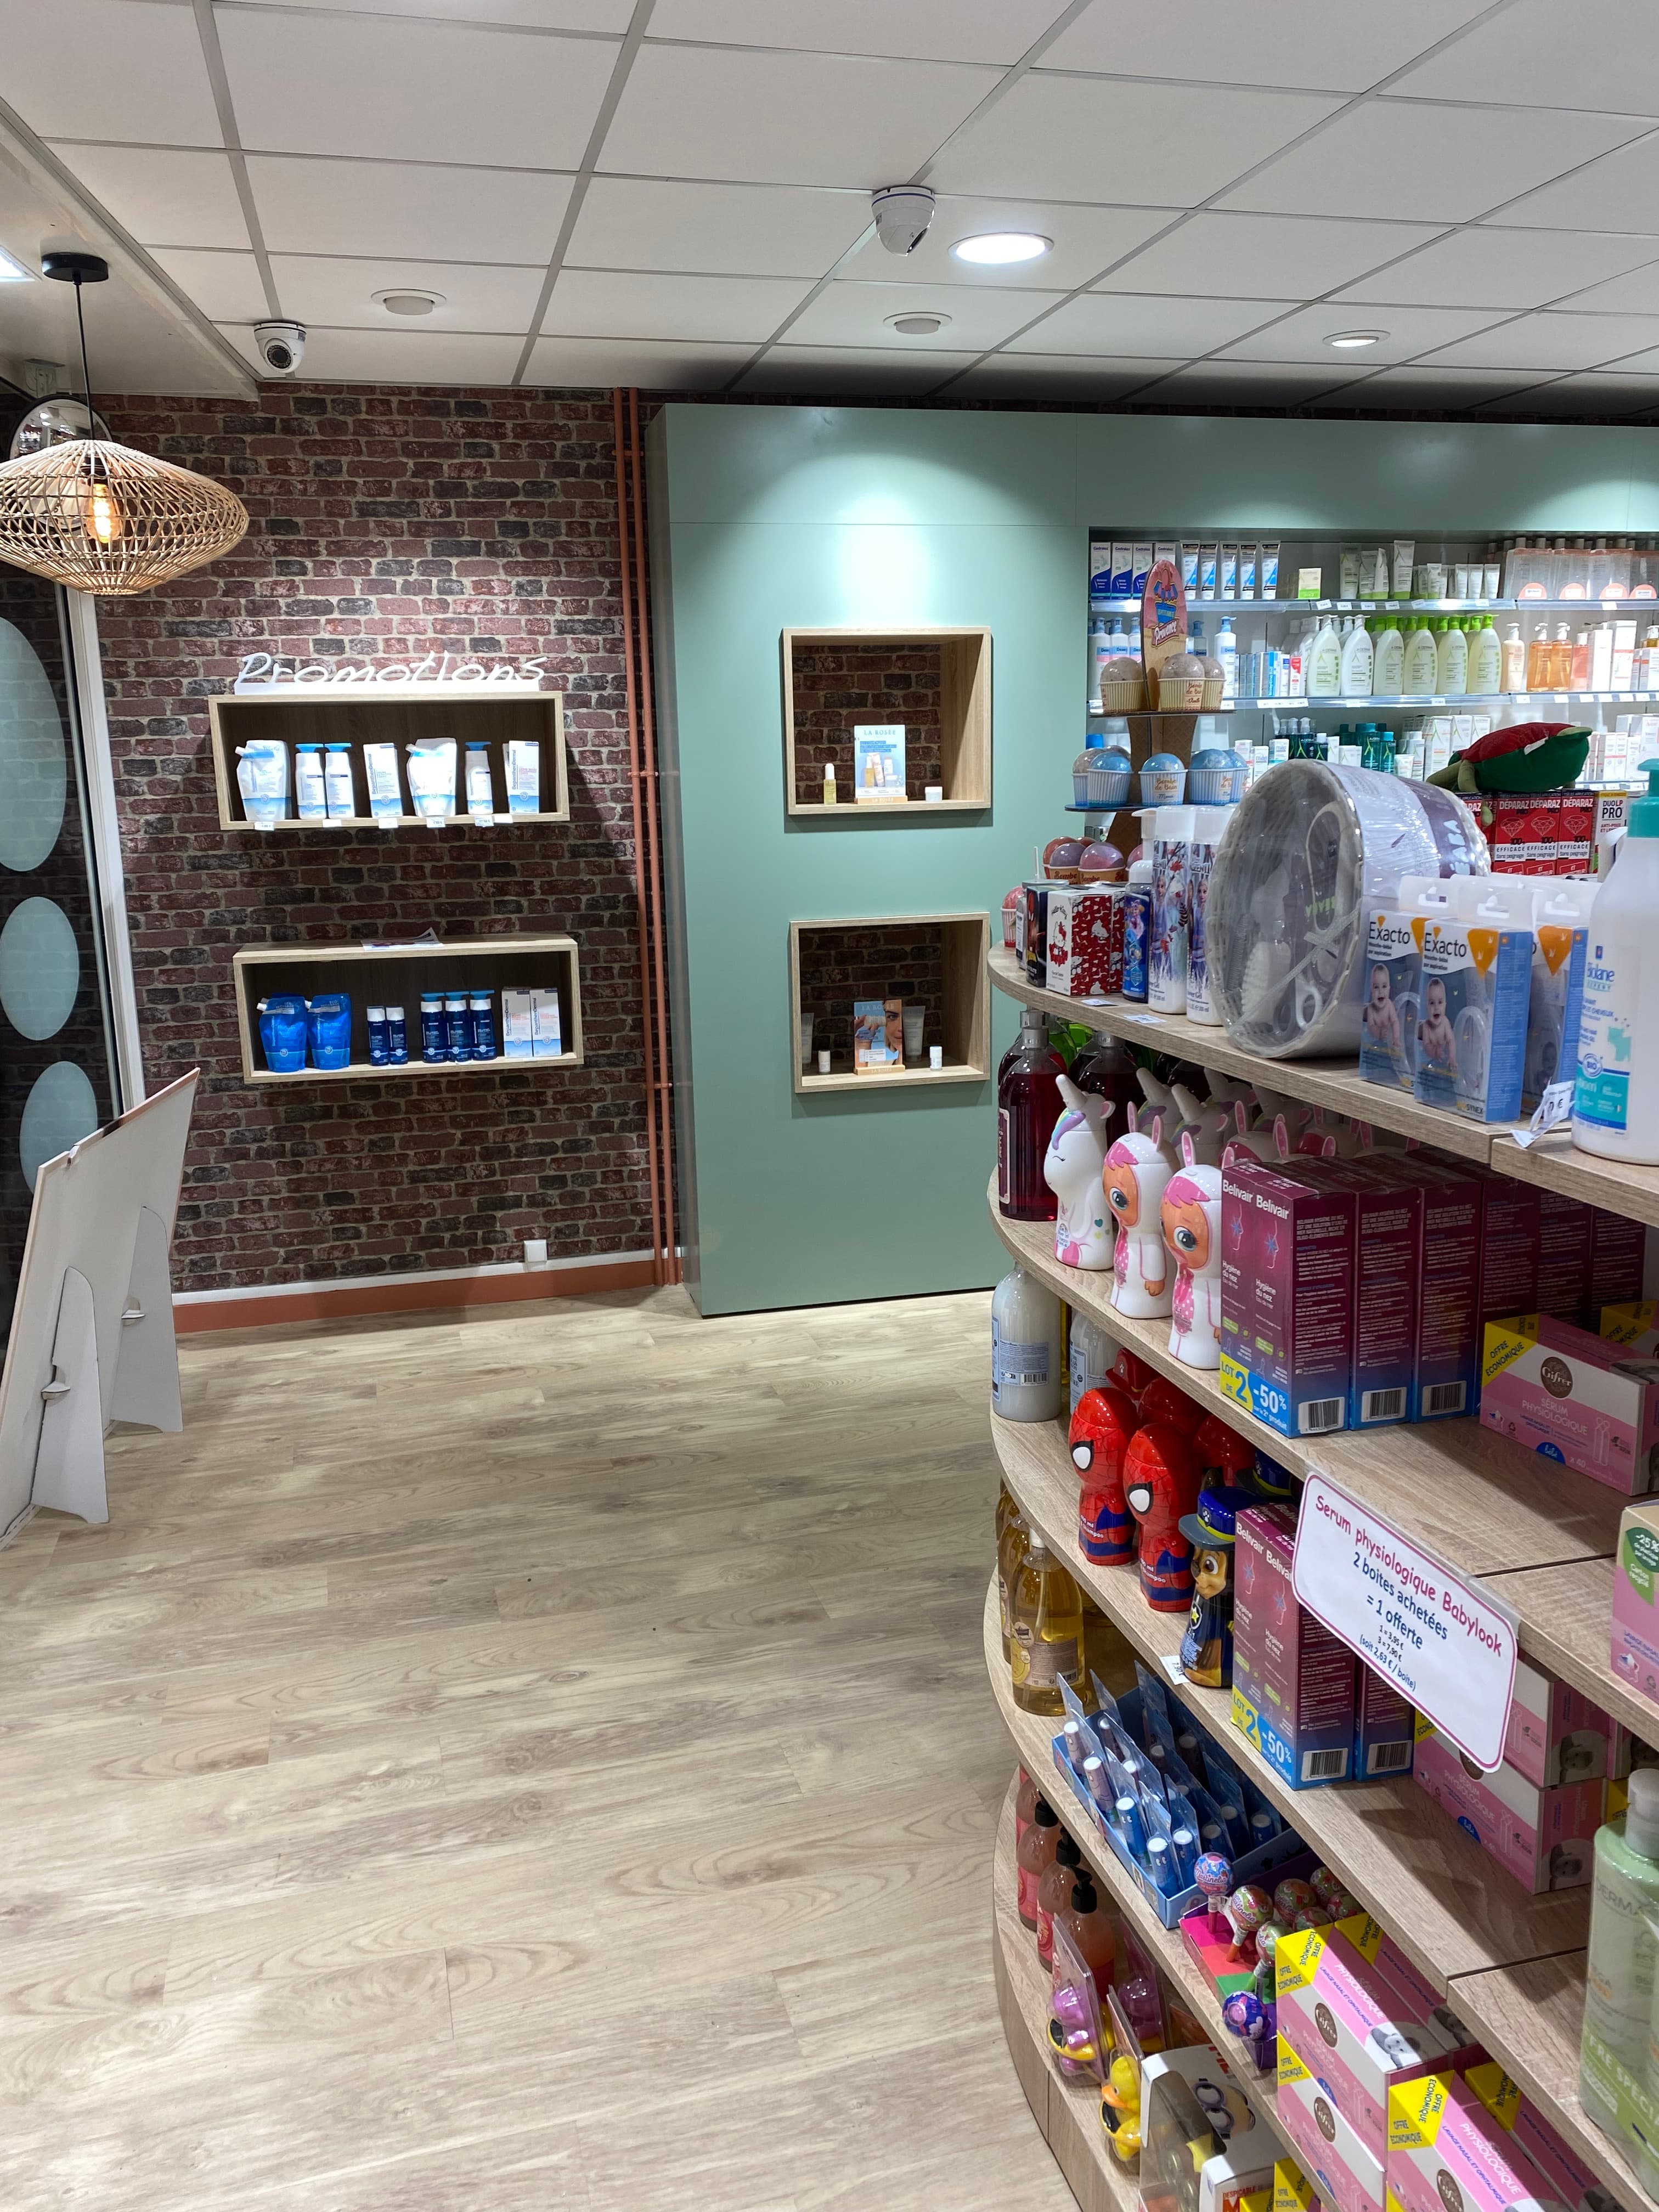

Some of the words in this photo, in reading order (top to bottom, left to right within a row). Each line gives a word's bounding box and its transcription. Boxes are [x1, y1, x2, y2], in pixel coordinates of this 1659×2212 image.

[238, 650, 548, 684] Promotions
[1499, 798, 1529, 809] DÉPARAZ
[1530, 798, 1560, 809] DÉPARAZ
[1564, 797, 1593, 808] DÉPARAZ
[1601, 807, 1623, 819] PRO
[1054, 871, 1077, 880] Bombe
[1369, 921, 1410, 944] Exacto
[1424, 933, 1466, 957] Exacto
[1222, 1180, 1253, 1203] Belivair
[1256, 1195, 1289, 1220] Belivair
[1223, 1260, 1241, 1276] Hygiène
[1228, 1273, 1238, 1283] nez
[1256, 1279, 1276, 1295] Hygiène
[1263, 1291, 1273, 1302] nez
[1486, 1342, 1525, 1377] ECONOMIQUE
[1490, 1340, 1509, 1359] OFFRE
[1221, 1361, 1234, 1378] LOT
[1234, 1371, 1248, 1403] 2
[1226, 1383, 1233, 1393] DE
[1542, 1366, 1572, 1387] Gifrer
[1253, 1384, 1287, 1414] -50%
[1541, 1397, 1568, 1417] SÉRUM
[1522, 1400, 1588, 1436] PHYSIOLOGIQUE
[1236, 1522, 1264, 1554] Belivair
[1266, 1550, 1292, 1582] Belivai
[1316, 1495, 1351, 1535] Serum
[1355, 1527, 1436, 1601] physiologique
[1442, 1591, 1503, 1657] Babylook
[1353, 1551, 1359, 1567] 2
[1362, 1558, 1395, 1596] boites
[1397, 1591, 1448, 1640] achetées
[1376, 1600, 1383, 1615] 1
[1386, 1610, 1423, 1649] offerte
[1378, 1636, 1382, 1644] 3
[1386, 1644, 1398, 1658] 7,90
[1398, 1654, 1403, 1662] €
[1379, 1625, 1384, 1633] 1
[1388, 1631, 1398, 1645] 3,95
[1400, 1642, 1404, 1651] €
[1359, 1634, 1374, 1652] (soit
[1374, 1647, 1387, 1663] 2,63
[1388, 1660, 1393, 1668] €
[1397, 1668, 1417, 1692] boite)
[1233, 1694, 1245, 1713] LOT
[1245, 1708, 1256, 1742] 2
[1262, 1730, 1292, 1763] -50%
[1300, 1931, 1317, 1966] ECONOMIQUE
[1311, 1942, 1322, 1958] OFFRE
[1335, 1963, 1384, 2019] PHYSIOLOGIQUE
[1419, 2079, 1436, 2123] ECONOMIQUE
[1431, 2094, 1442, 2114] OFFRE
[1393, 2119, 1409, 2130] OFFRE
[1390, 2132, 1422, 2145] ECONOMIQUE
[1442, 2125, 1459, 2145] LAVAGE
[1457, 2143, 1472, 2164] NASAL
[1471, 2162, 1479, 2170] ET
[1459, 2123, 1522, 2195] PHYSIOLOGIQUE
